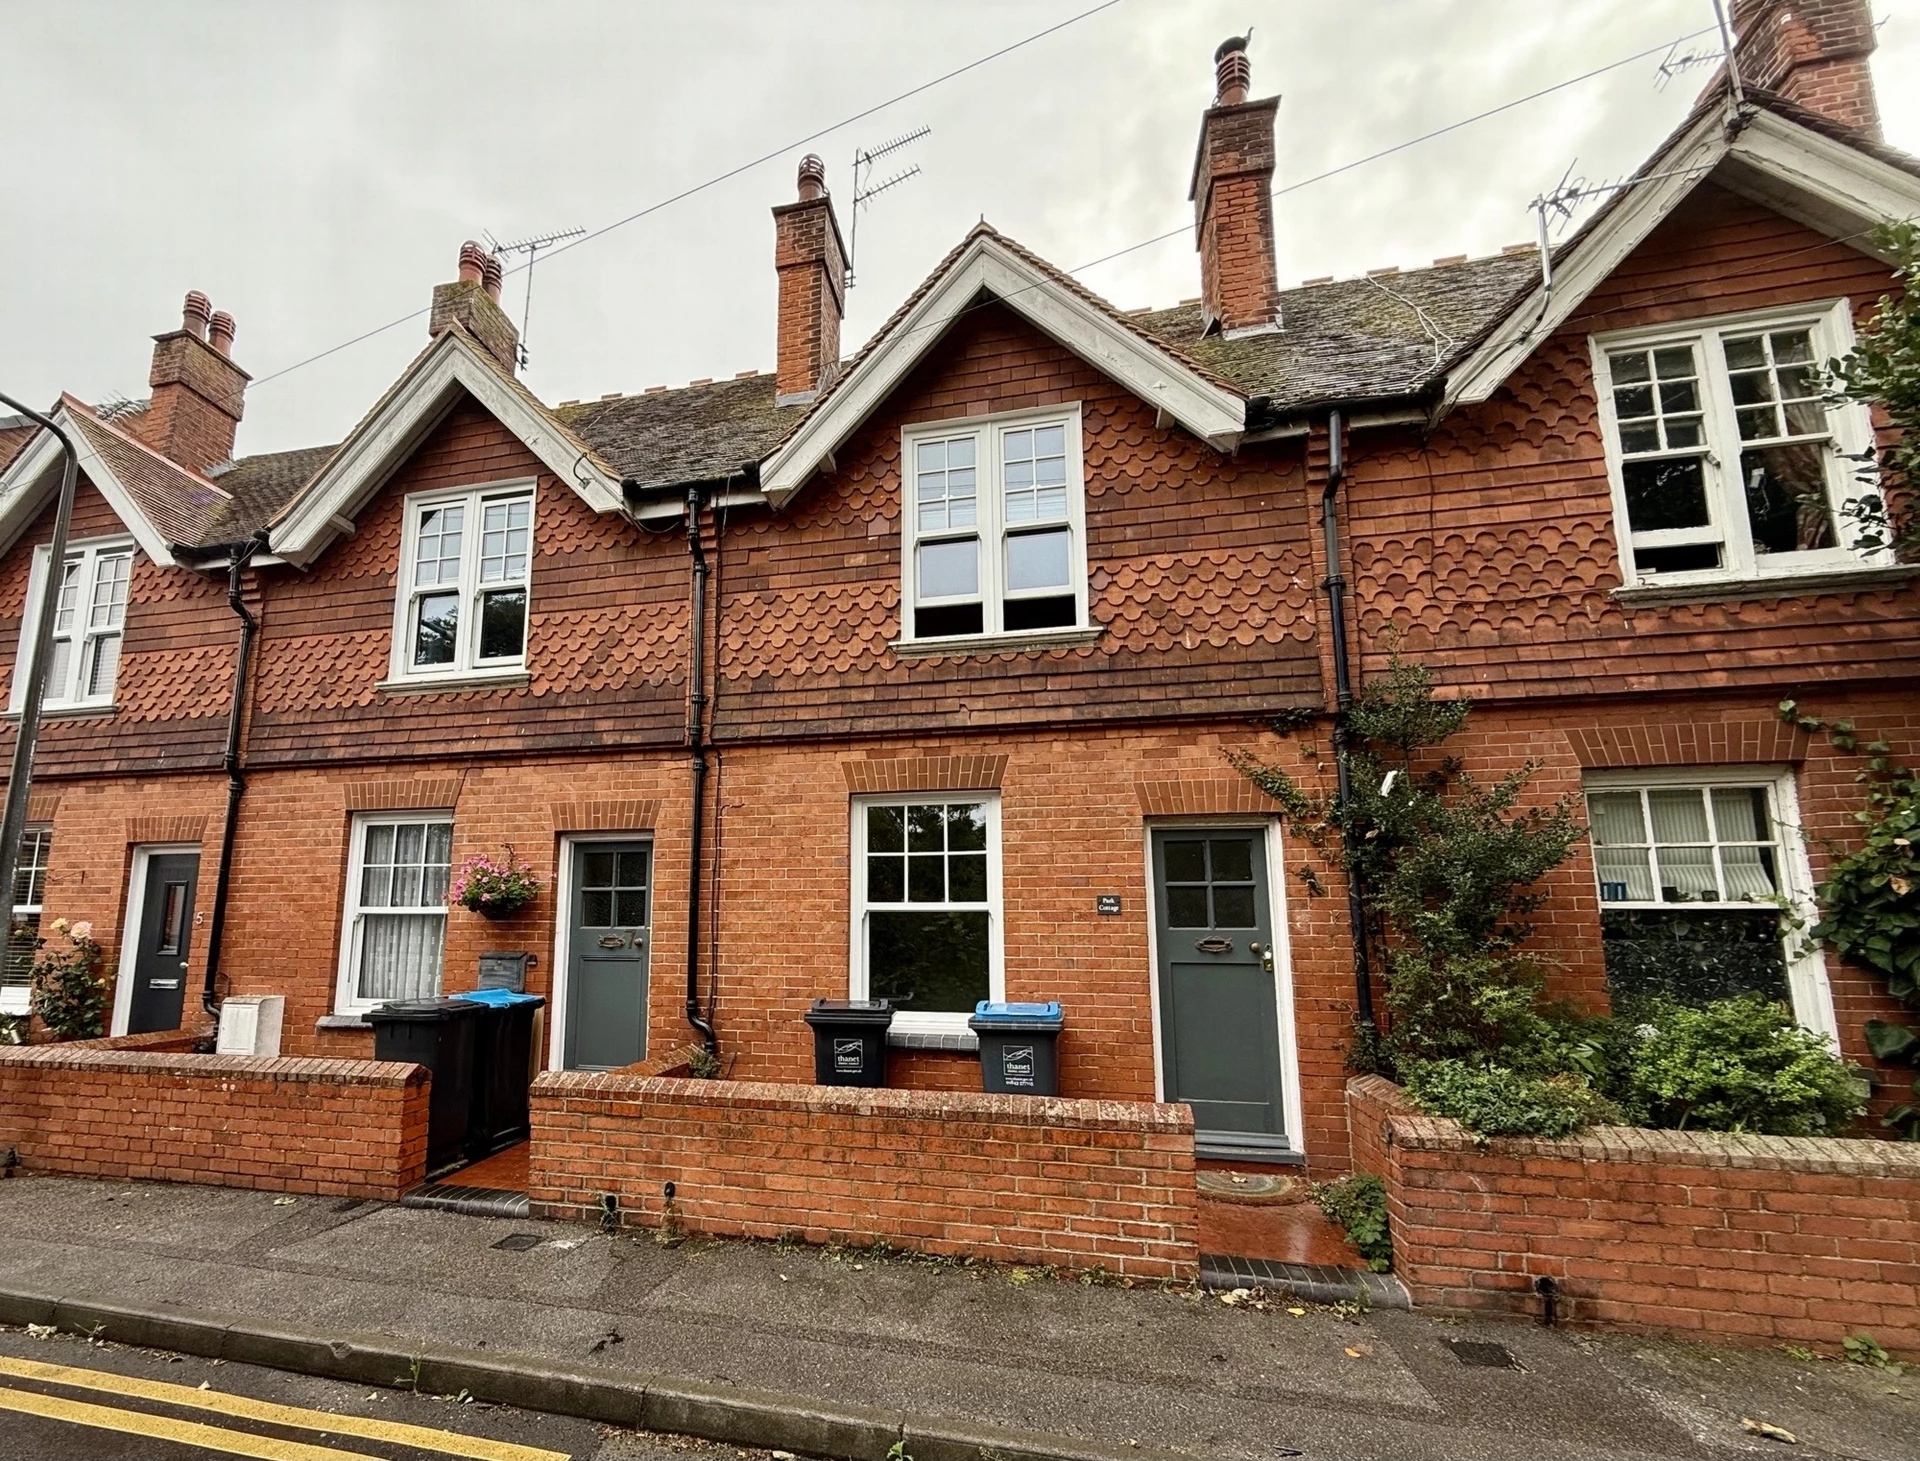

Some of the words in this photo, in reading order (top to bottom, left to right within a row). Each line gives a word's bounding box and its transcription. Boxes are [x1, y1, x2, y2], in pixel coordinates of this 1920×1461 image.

[1098, 904, 1119, 912] Cottage
[195, 911, 204, 925] 5
[623, 929, 636, 949] 7
[1006, 1062, 1031, 1070] thanet
